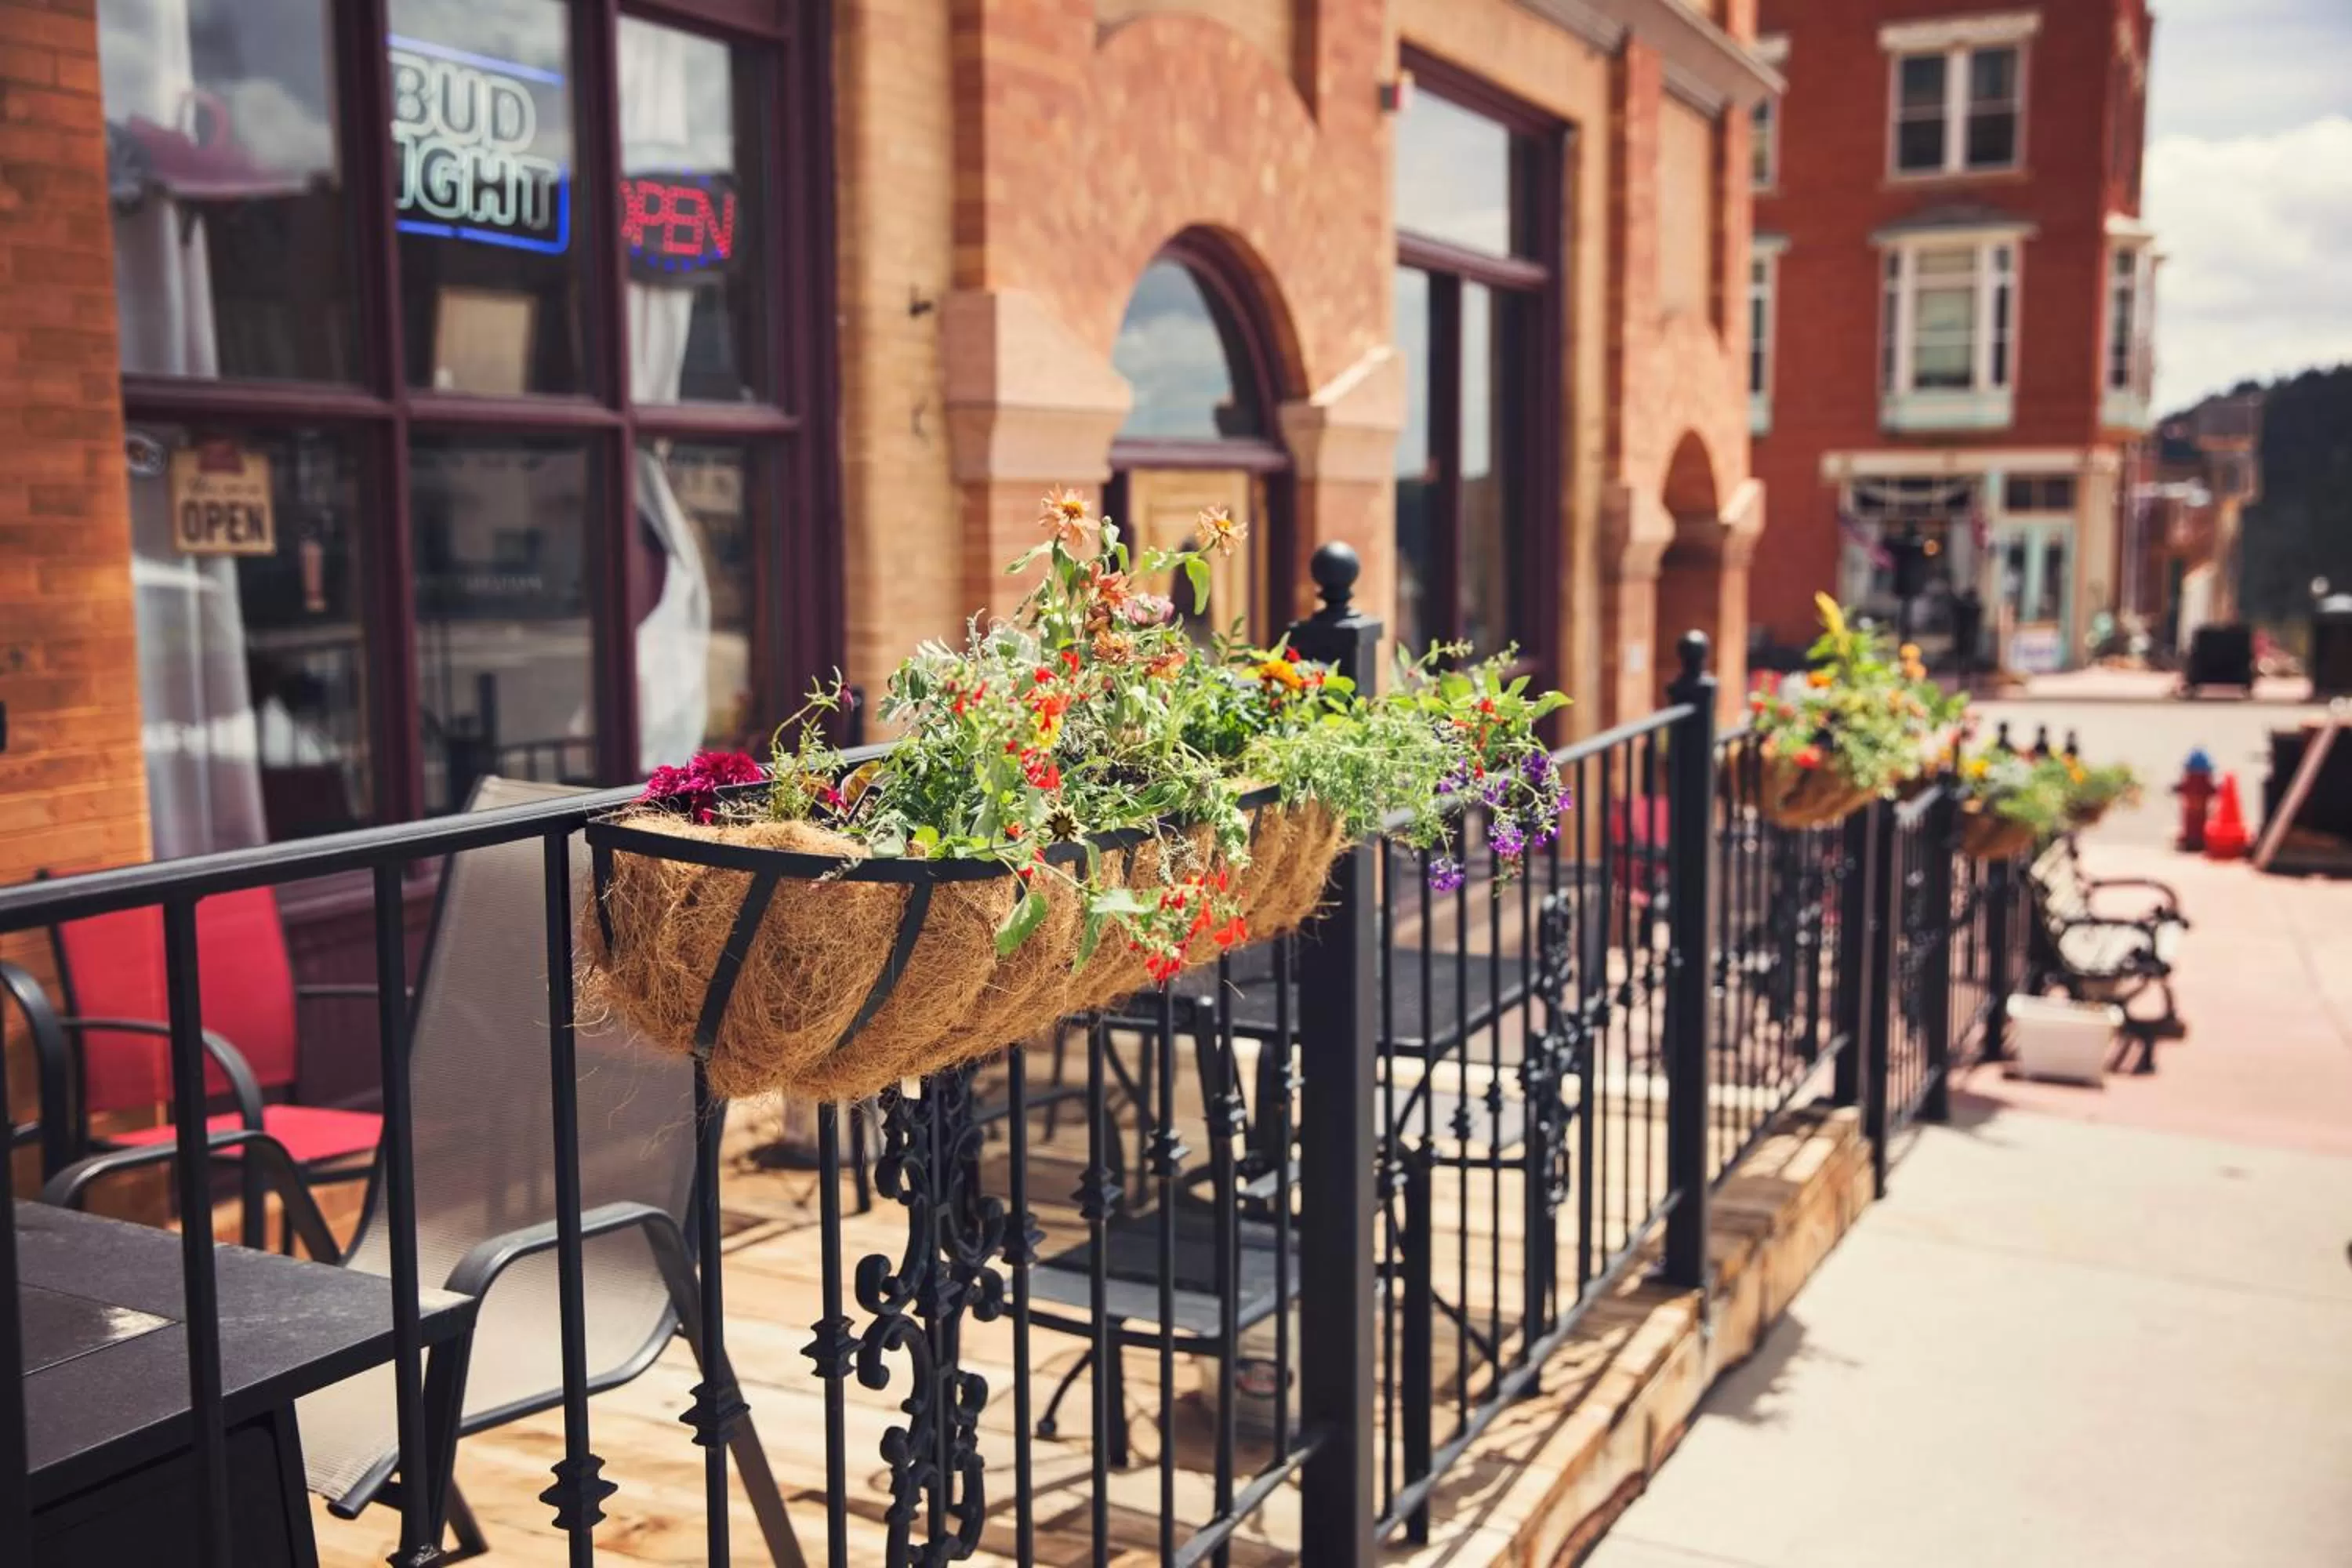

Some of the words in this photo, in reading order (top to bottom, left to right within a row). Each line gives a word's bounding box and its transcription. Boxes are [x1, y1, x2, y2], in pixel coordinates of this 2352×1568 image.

[388, 52, 536, 153] BUD
[392, 136, 560, 230] IGHT
[181, 499, 266, 543] OPEN
